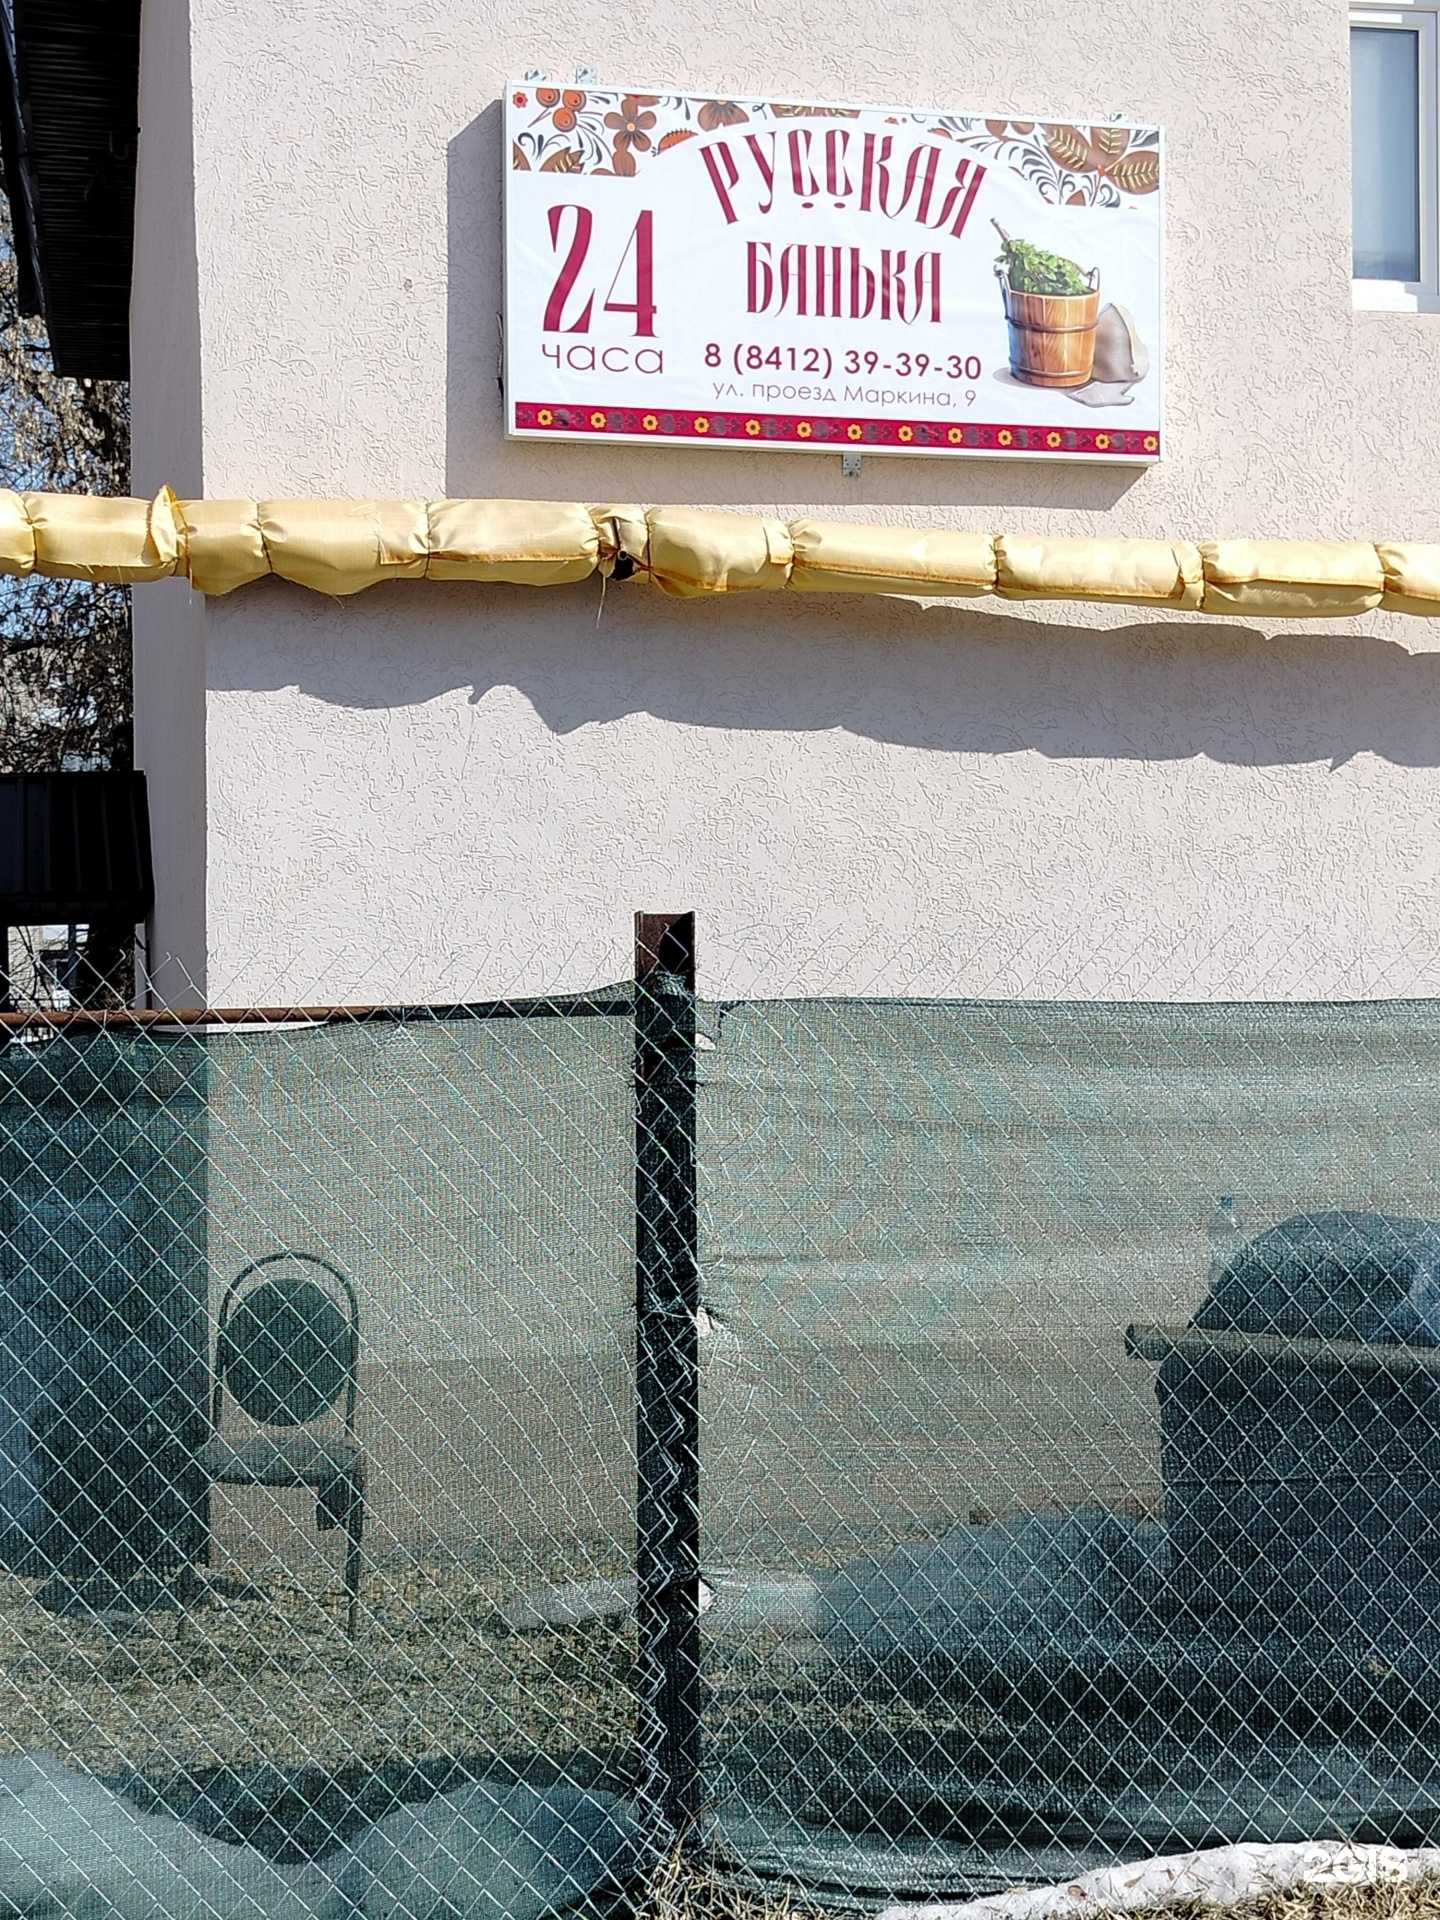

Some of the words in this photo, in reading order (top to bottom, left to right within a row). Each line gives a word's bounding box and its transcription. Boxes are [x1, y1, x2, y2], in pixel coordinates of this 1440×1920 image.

[699, 129, 987, 239] РУССКАЯ
[542, 204, 660, 339] 24
[745, 241, 942, 325] БАНЬКА
[541, 343, 664, 375] часа
[703, 342, 722, 368] 8
[731, 344, 833, 380] (8412)
[844, 349, 982, 381] 39-39-30
[712, 382, 744, 400] ул.
[752, 382, 837, 402] проезд
[844, 385, 957, 408] Маркина,
[964, 389, 977, 407] 9
